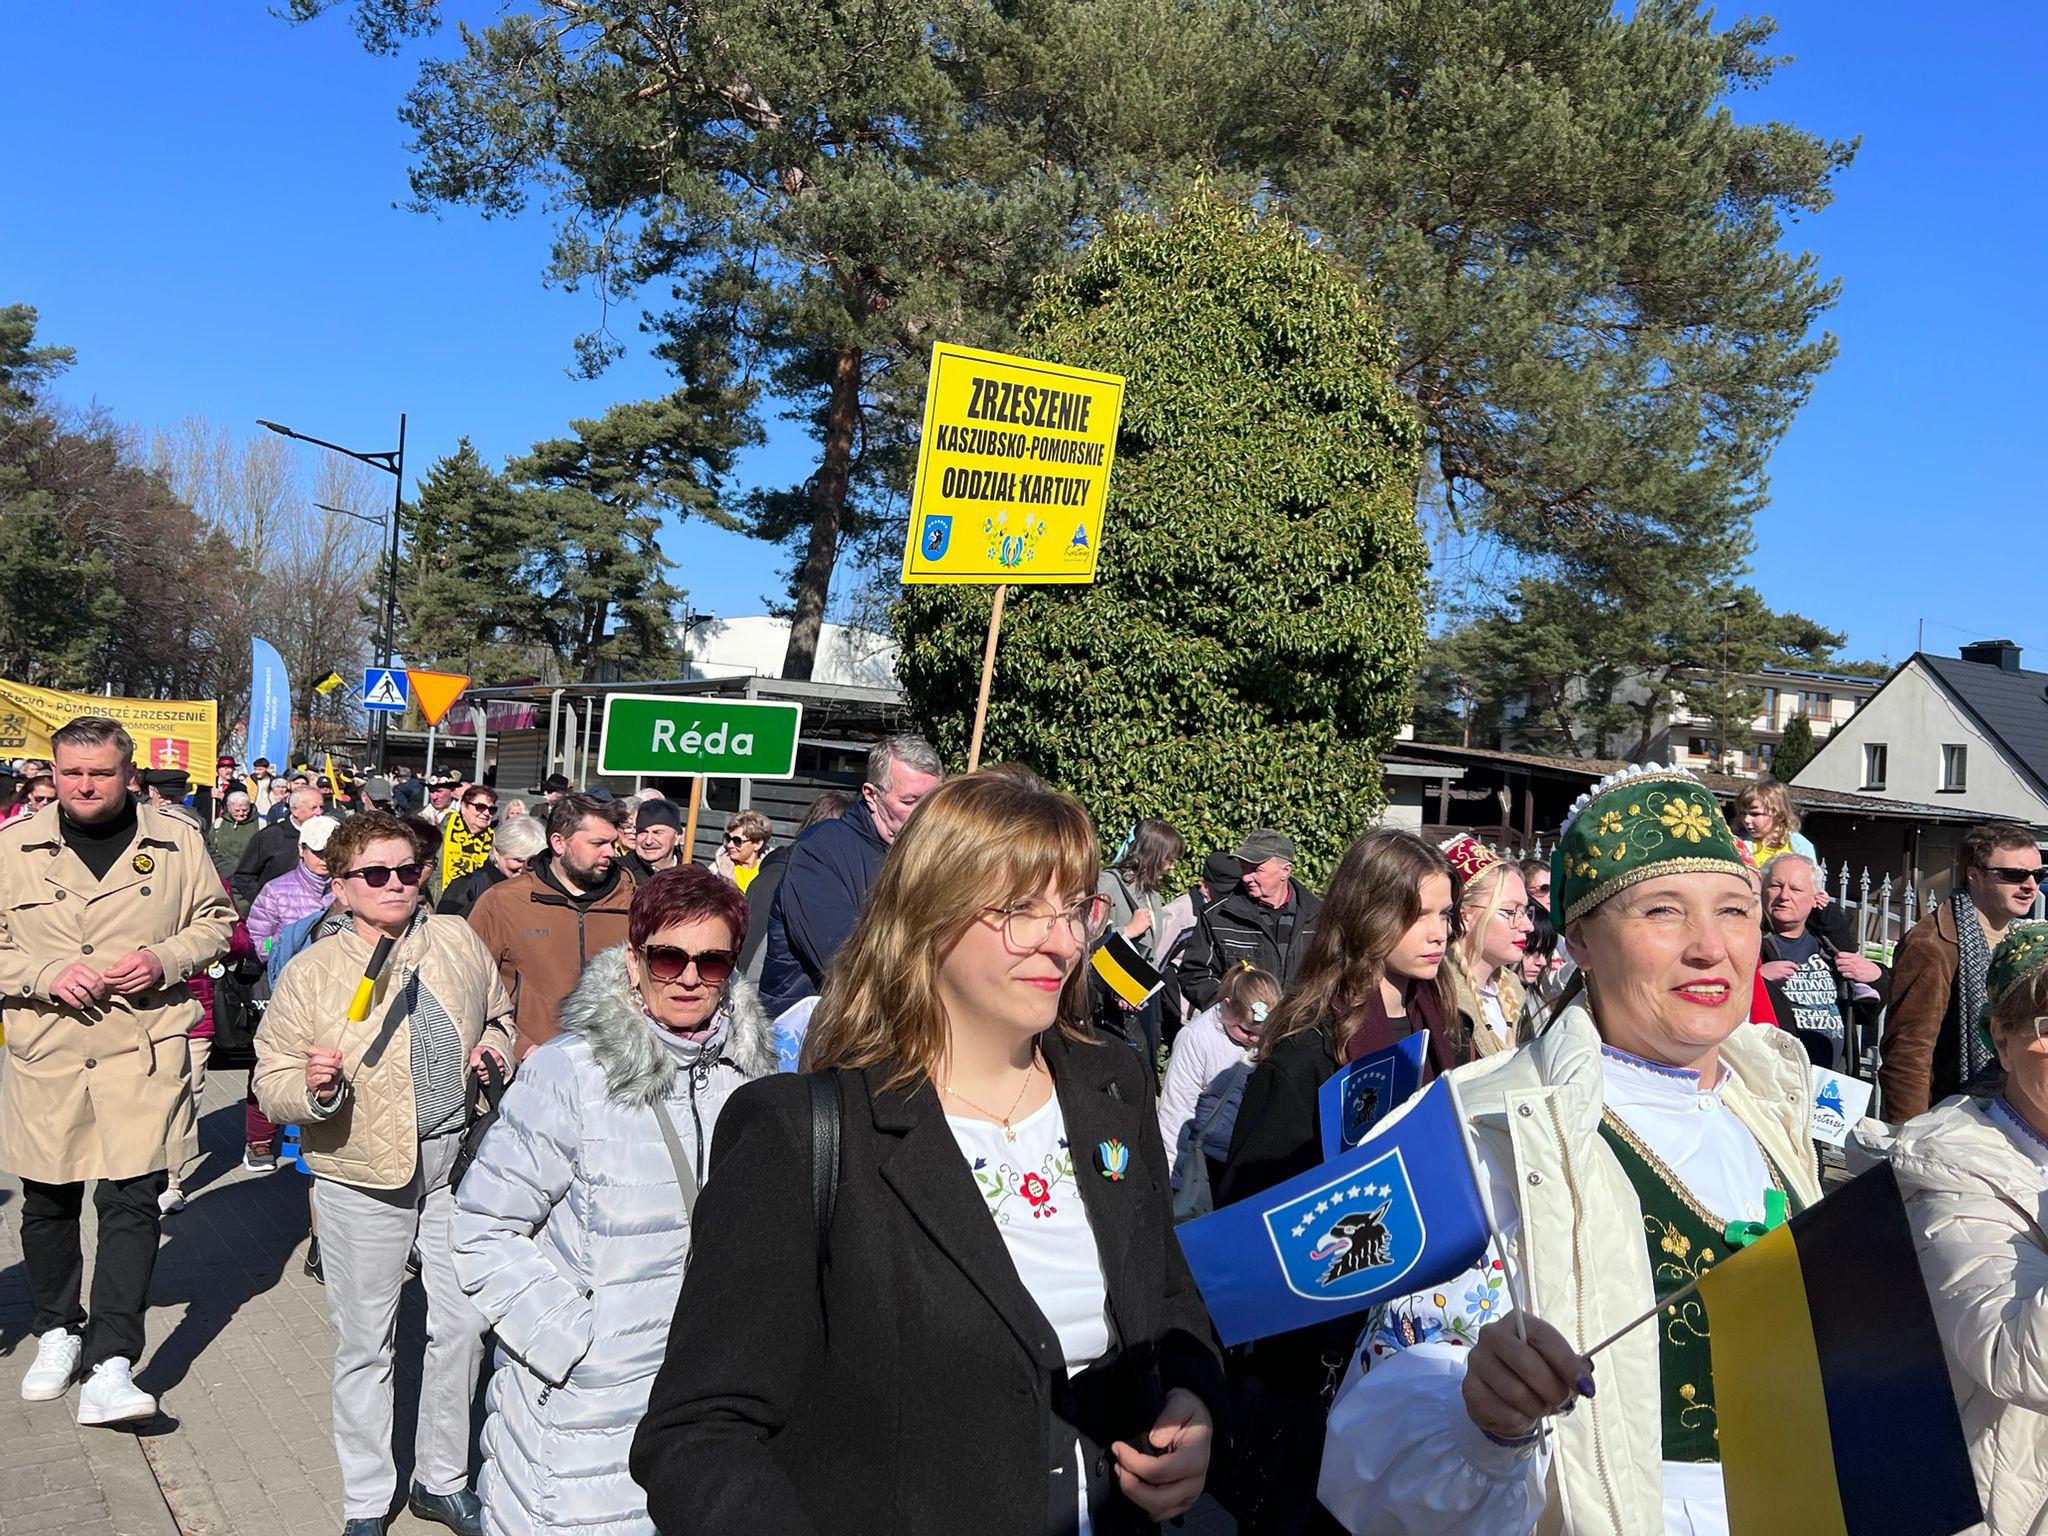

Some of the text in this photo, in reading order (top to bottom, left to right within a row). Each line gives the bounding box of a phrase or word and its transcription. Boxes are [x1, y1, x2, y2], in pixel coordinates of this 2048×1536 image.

[967, 377, 1092, 433] ZRZESZENIE
[936, 424, 1105, 467] KASZUBSKO-POMORSKIE
[942, 467, 1091, 507] ODDZIAŁ KARTUZY
[133, 709, 206, 722] ZRZESZENIÉ
[651, 719, 754, 756] Réda
